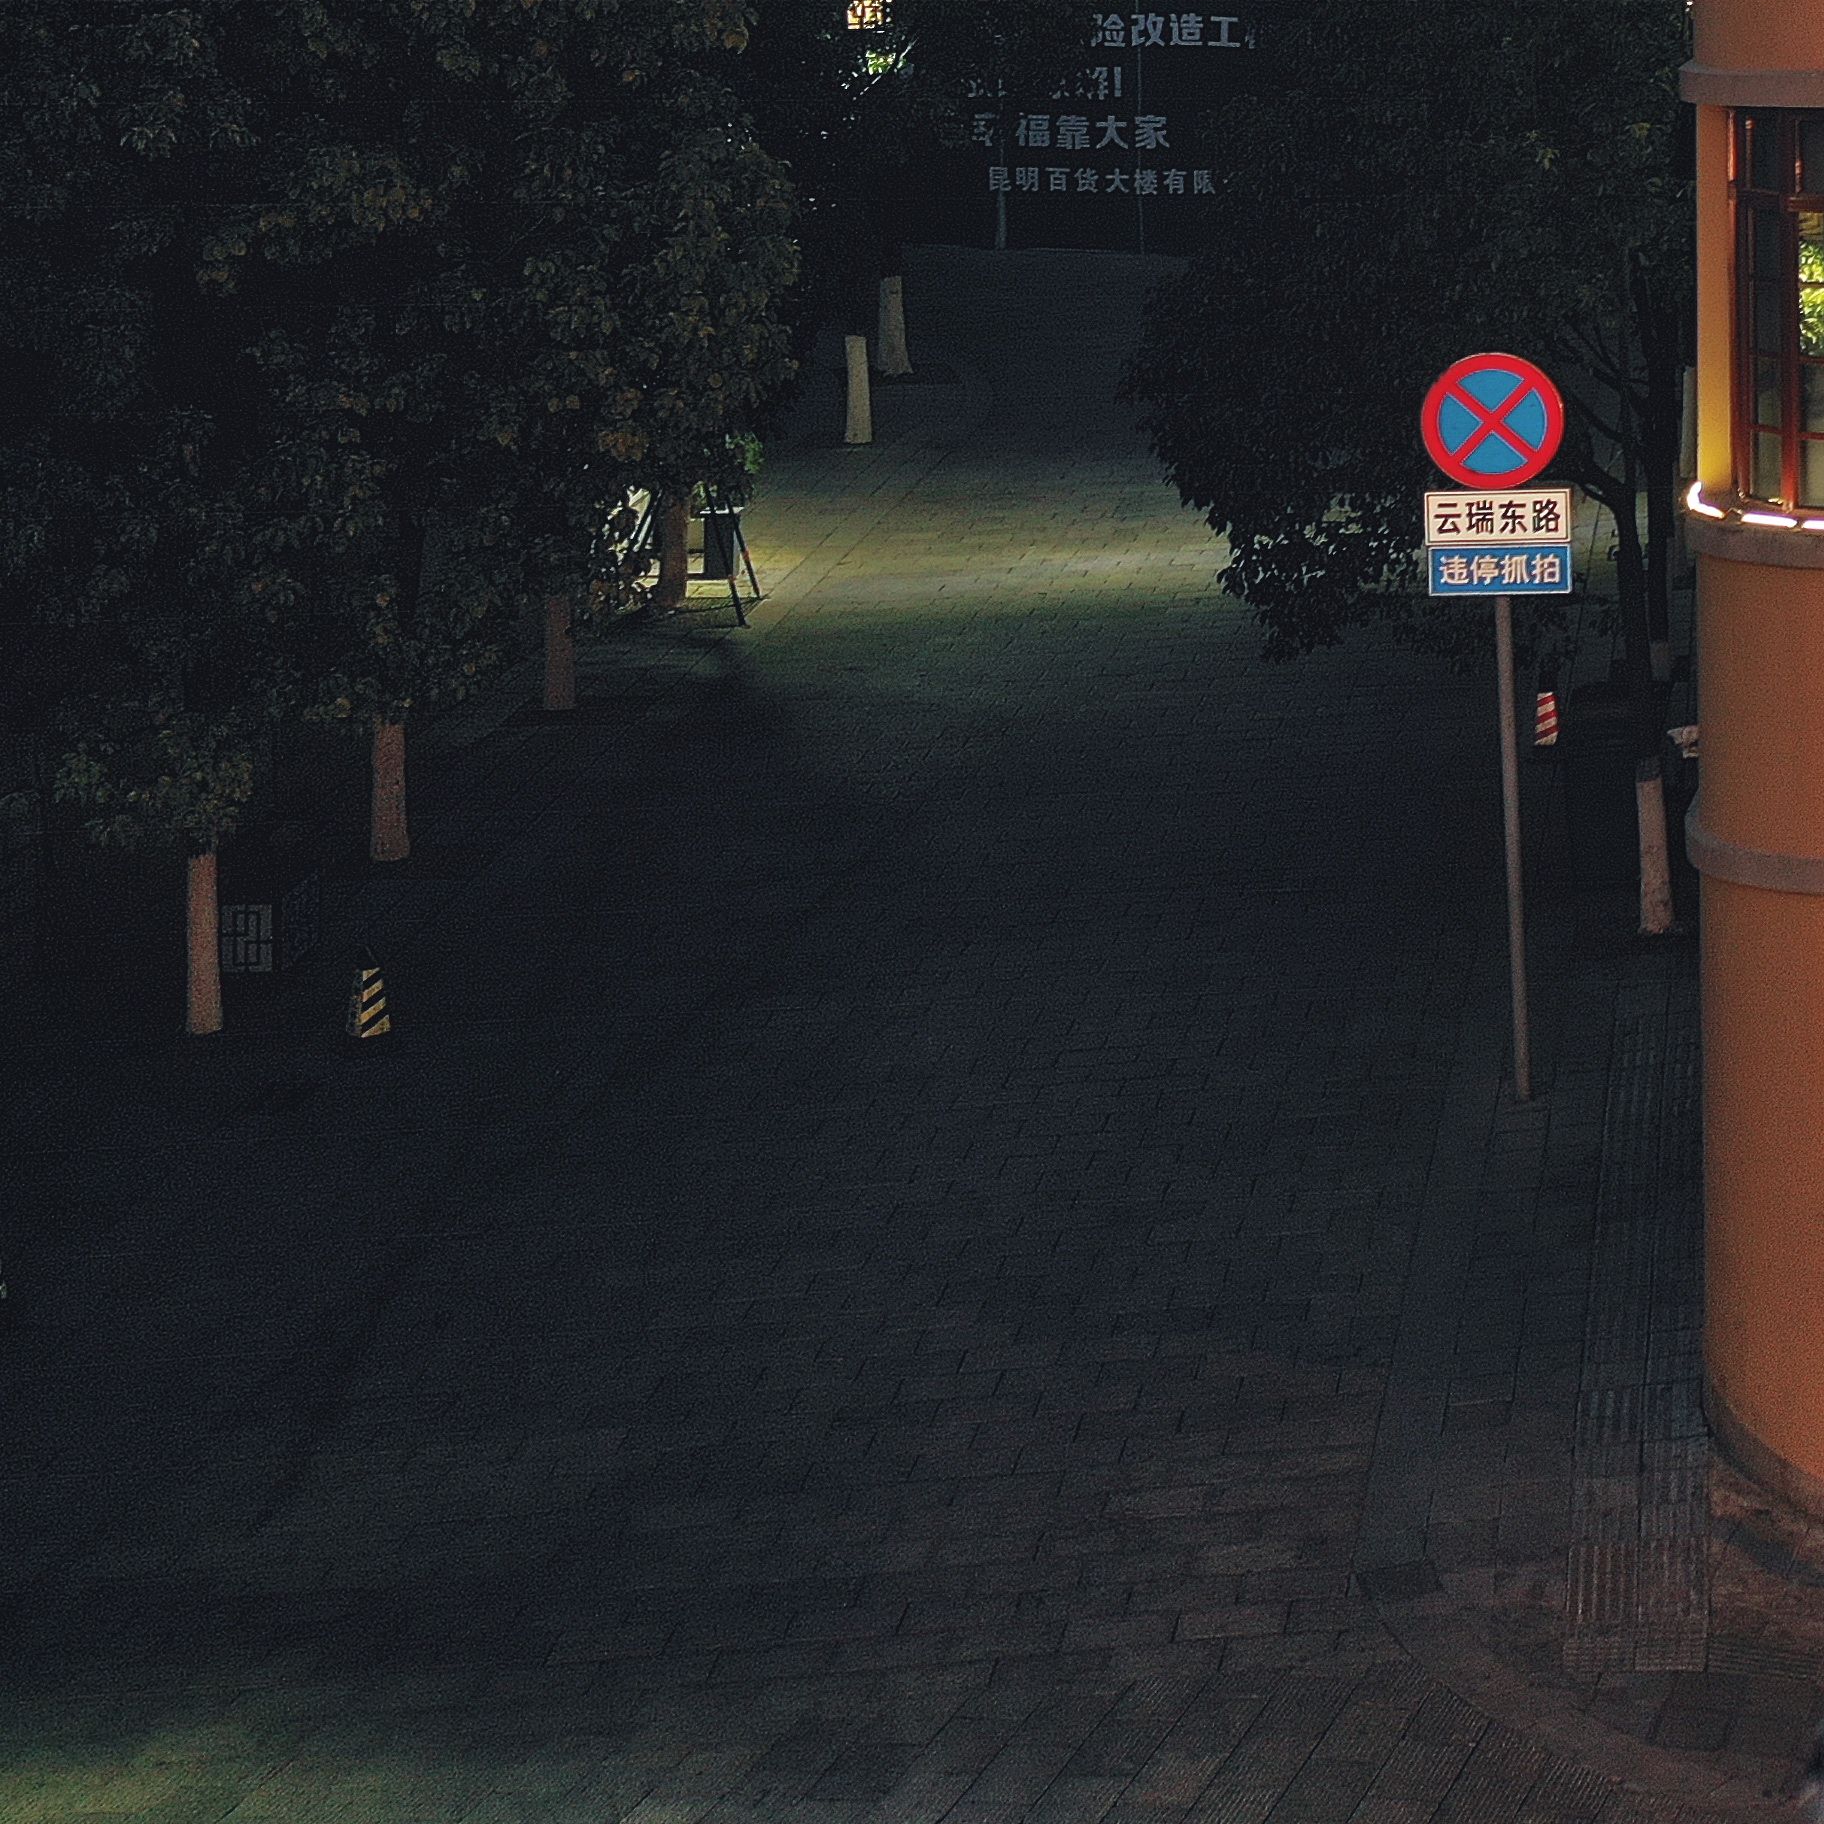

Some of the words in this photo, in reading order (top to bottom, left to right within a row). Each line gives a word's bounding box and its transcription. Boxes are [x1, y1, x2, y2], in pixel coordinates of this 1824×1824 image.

[1090, 12, 1257, 49] 险改造工
[1434, 499, 1561, 534] 云瑞东路
[1438, 553, 1561, 585] 违停抓拍
